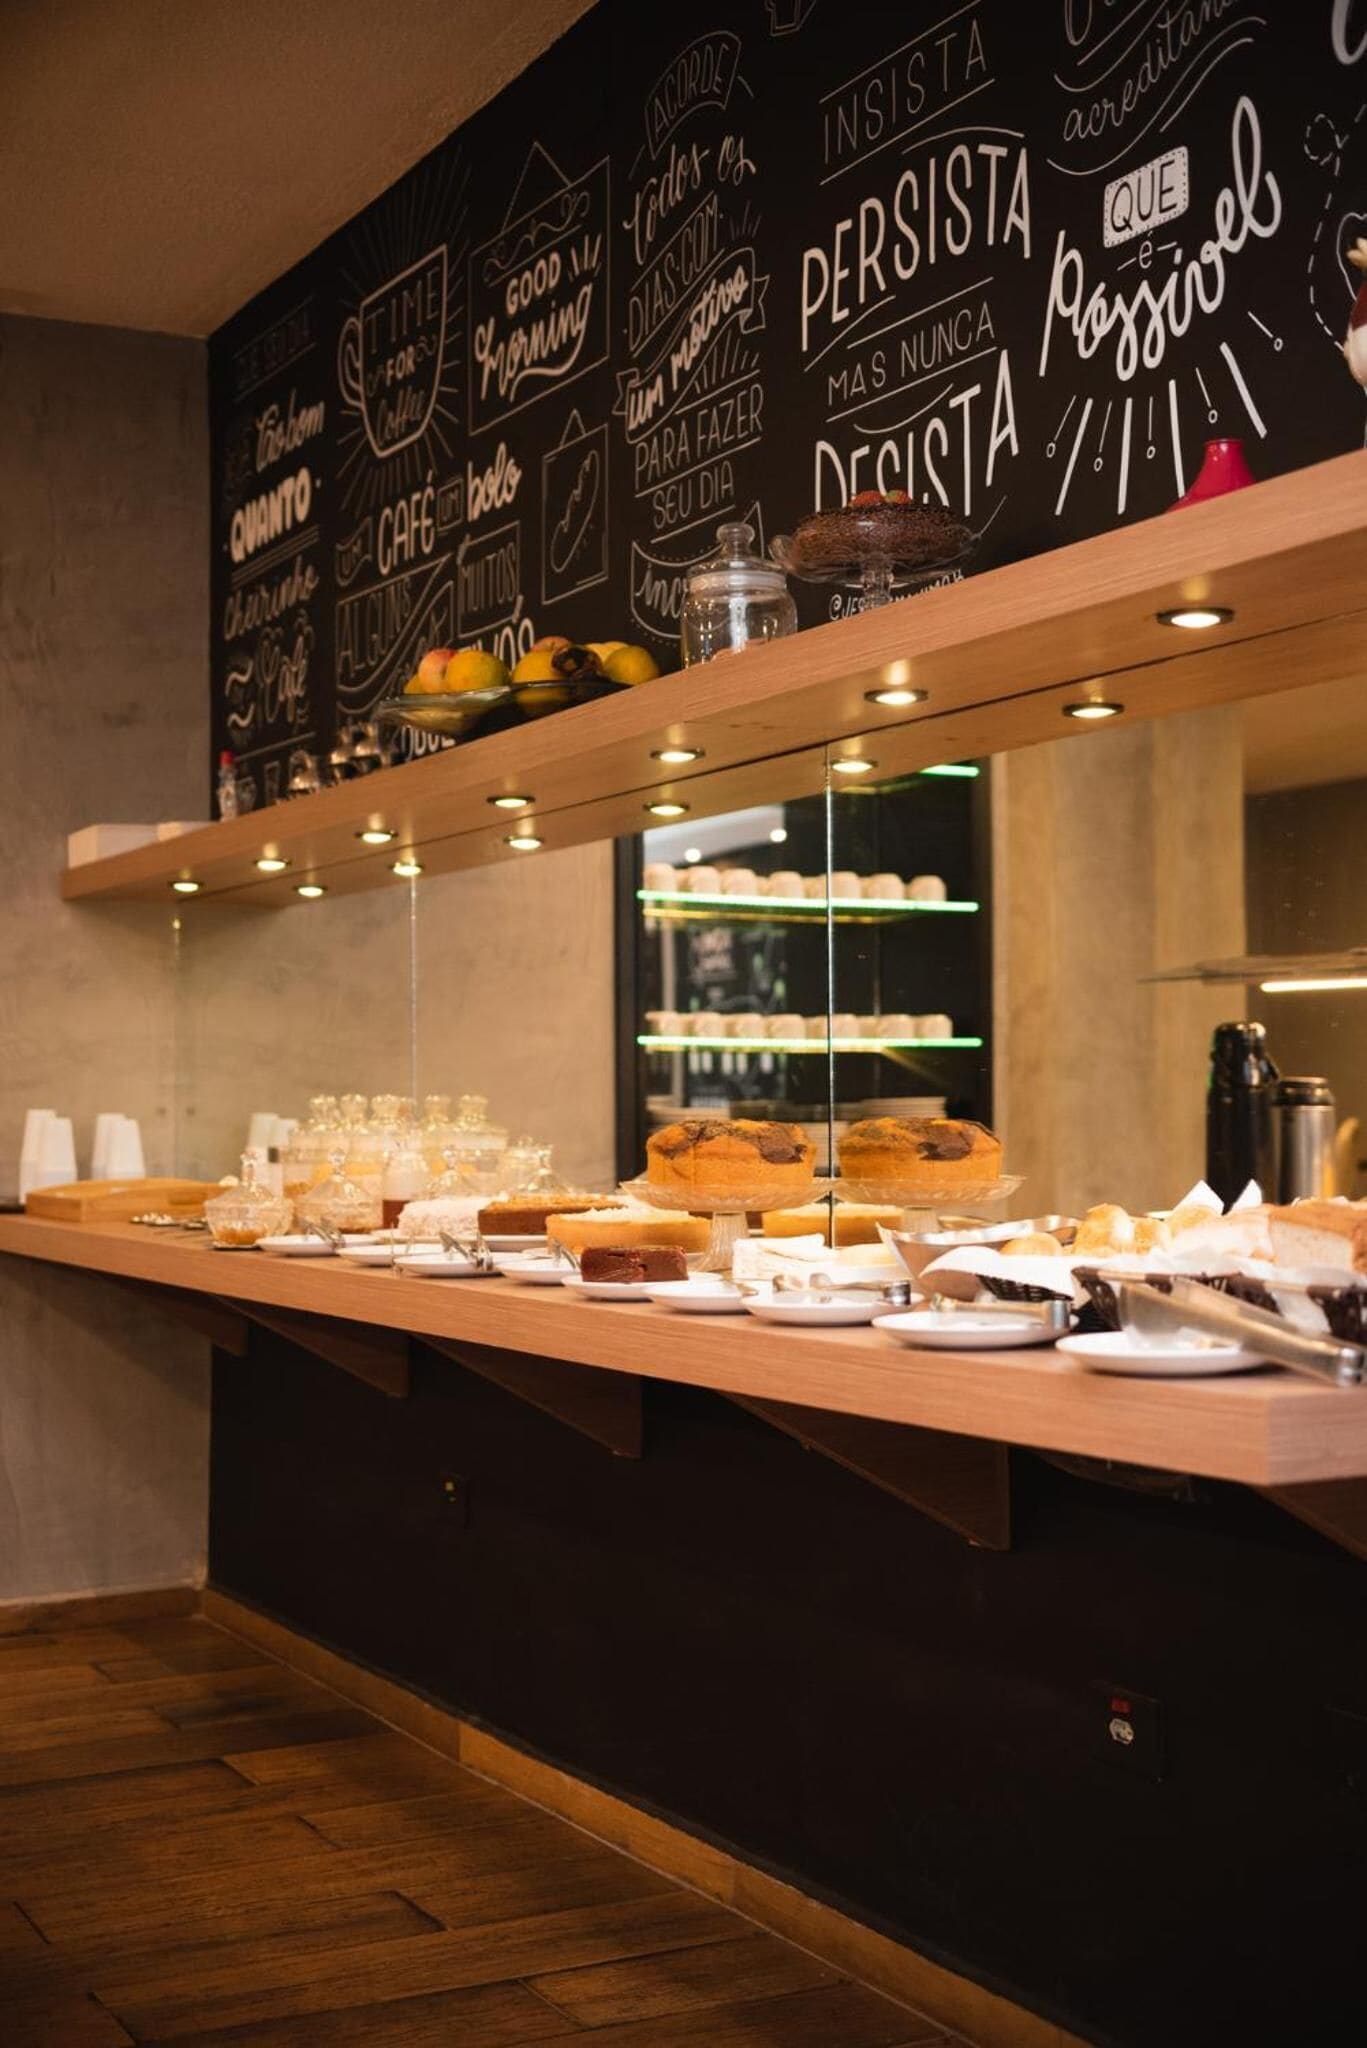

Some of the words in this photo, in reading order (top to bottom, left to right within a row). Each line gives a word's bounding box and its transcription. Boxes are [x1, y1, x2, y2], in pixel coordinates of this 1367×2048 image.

[653, 42, 730, 143] ACORDE
[823, 17, 988, 167] INSISTA
[1064, 0, 1233, 142] acreditan
[801, 143, 1032, 353] PERSISTA
[1110, 159, 1178, 233] QUE
[365, 267, 440, 356] TIME
[505, 250, 563, 319] GOOD
[628, 251, 676, 353] DIAS
[681, 194, 719, 286] COM
[385, 344, 416, 387] FOR
[474, 281, 594, 403] Morning
[828, 350, 887, 407] MAS
[900, 300, 995, 378] NUNCA
[634, 419, 691, 491] PARA
[697, 382, 764, 459] FAZER
[230, 466, 312, 564] QUANTO
[378, 469, 435, 576] CAFÉ
[653, 478, 693, 530] SEU
[700, 459, 735, 509] DIA
[460, 541, 517, 614] MUITOS
